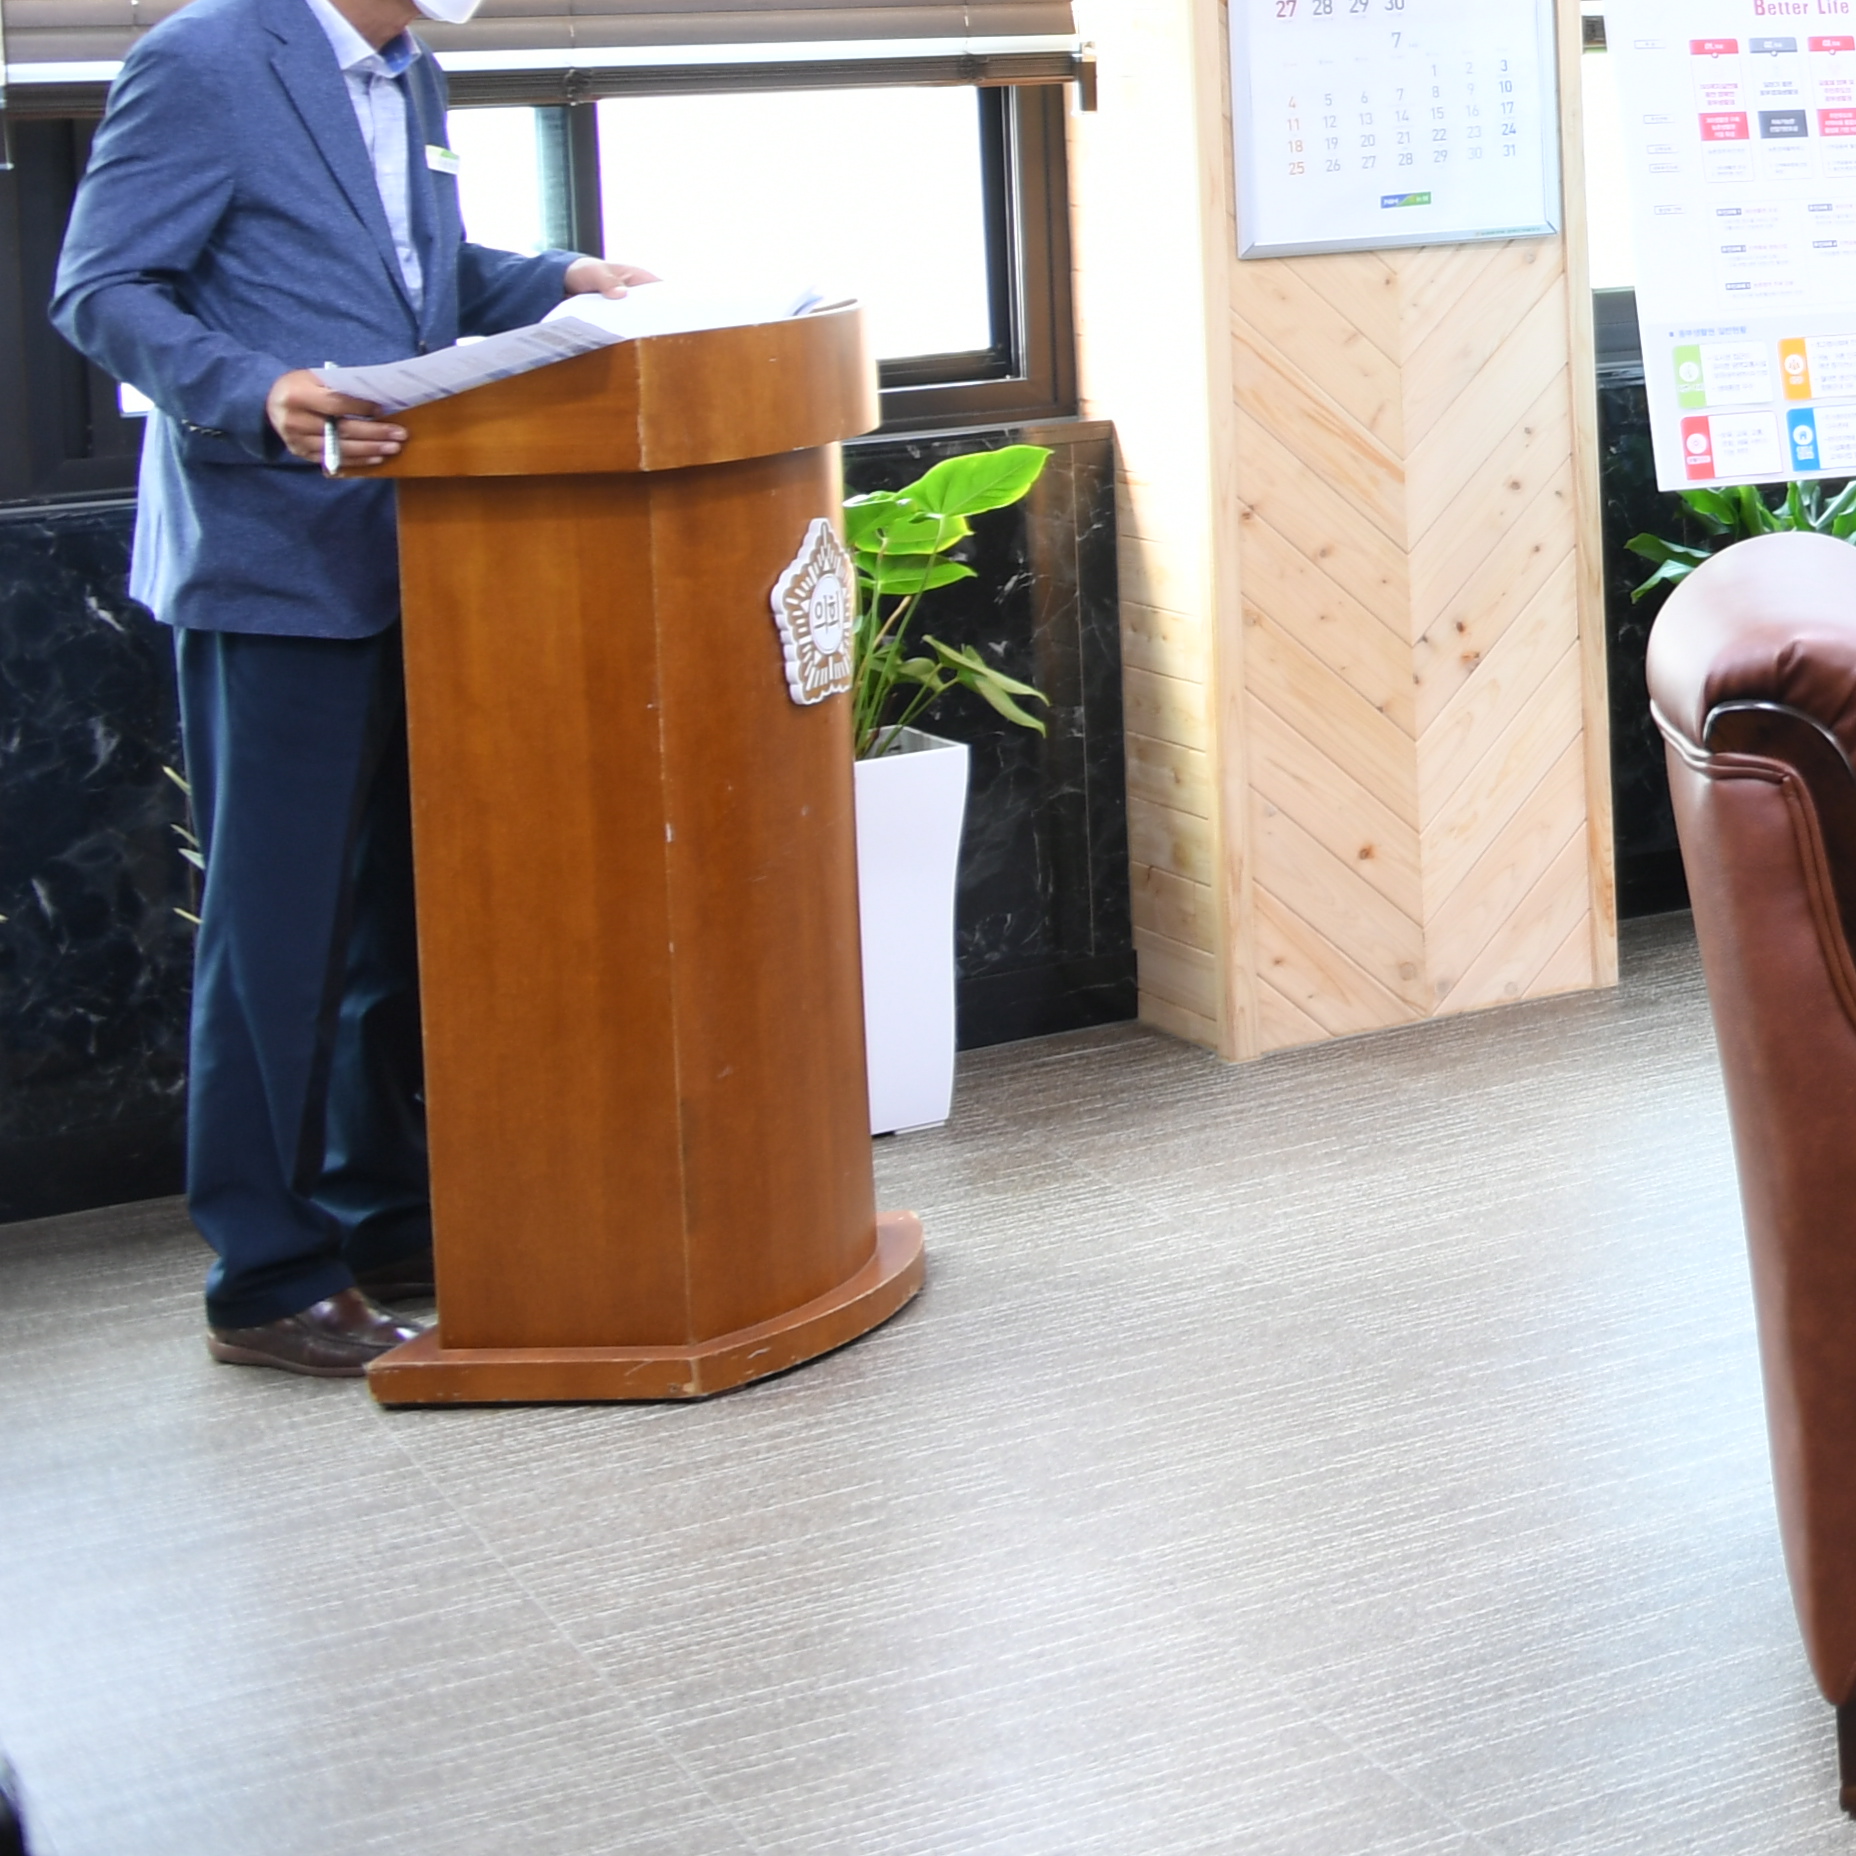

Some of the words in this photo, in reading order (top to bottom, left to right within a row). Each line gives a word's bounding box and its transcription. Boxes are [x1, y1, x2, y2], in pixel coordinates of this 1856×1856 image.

[1276, 0, 1297, 17] 27
[1392, 32, 1401, 48] 7
[1432, 64, 1436, 76] 1
[1466, 62, 1473, 74] 2
[1501, 60, 1507, 71] 3
[1289, 96, 1296, 108] 4
[1325, 93, 1332, 106] 5
[1361, 91, 1368, 103] 6
[1397, 88, 1403, 100] 7
[1432, 86, 1439, 98] 8
[1467, 83, 1474, 95] 9
[1499, 80, 1512, 93] 10
[1287, 118, 1299, 131] 11
[1323, 115, 1336, 128] 12
[1359, 112, 1373, 125] 13
[1395, 110, 1409, 122] 14
[1431, 107, 1444, 119] 15
[1466, 105, 1479, 116] 16
[1501, 101, 1514, 114] 17
[1288, 140, 1303, 153] 18
[1325, 137, 1338, 150] 19
[1360, 134, 1375, 147] 20
[1397, 131, 1410, 144] 21
[1432, 128, 1447, 141] 22
[1467, 126, 1481, 138] 23
[1502, 123, 1516, 135] 24
[1289, 161, 1304, 175] 25
[1326, 159, 1340, 172] 26
[1362, 156, 1376, 169] 27
[1399, 153, 1413, 166] 28
[1433, 150, 1448, 163] 29
[1468, 147, 1482, 160] 30
[1503, 144, 1515, 157] 31
[813, 590, 840, 634] 의회
